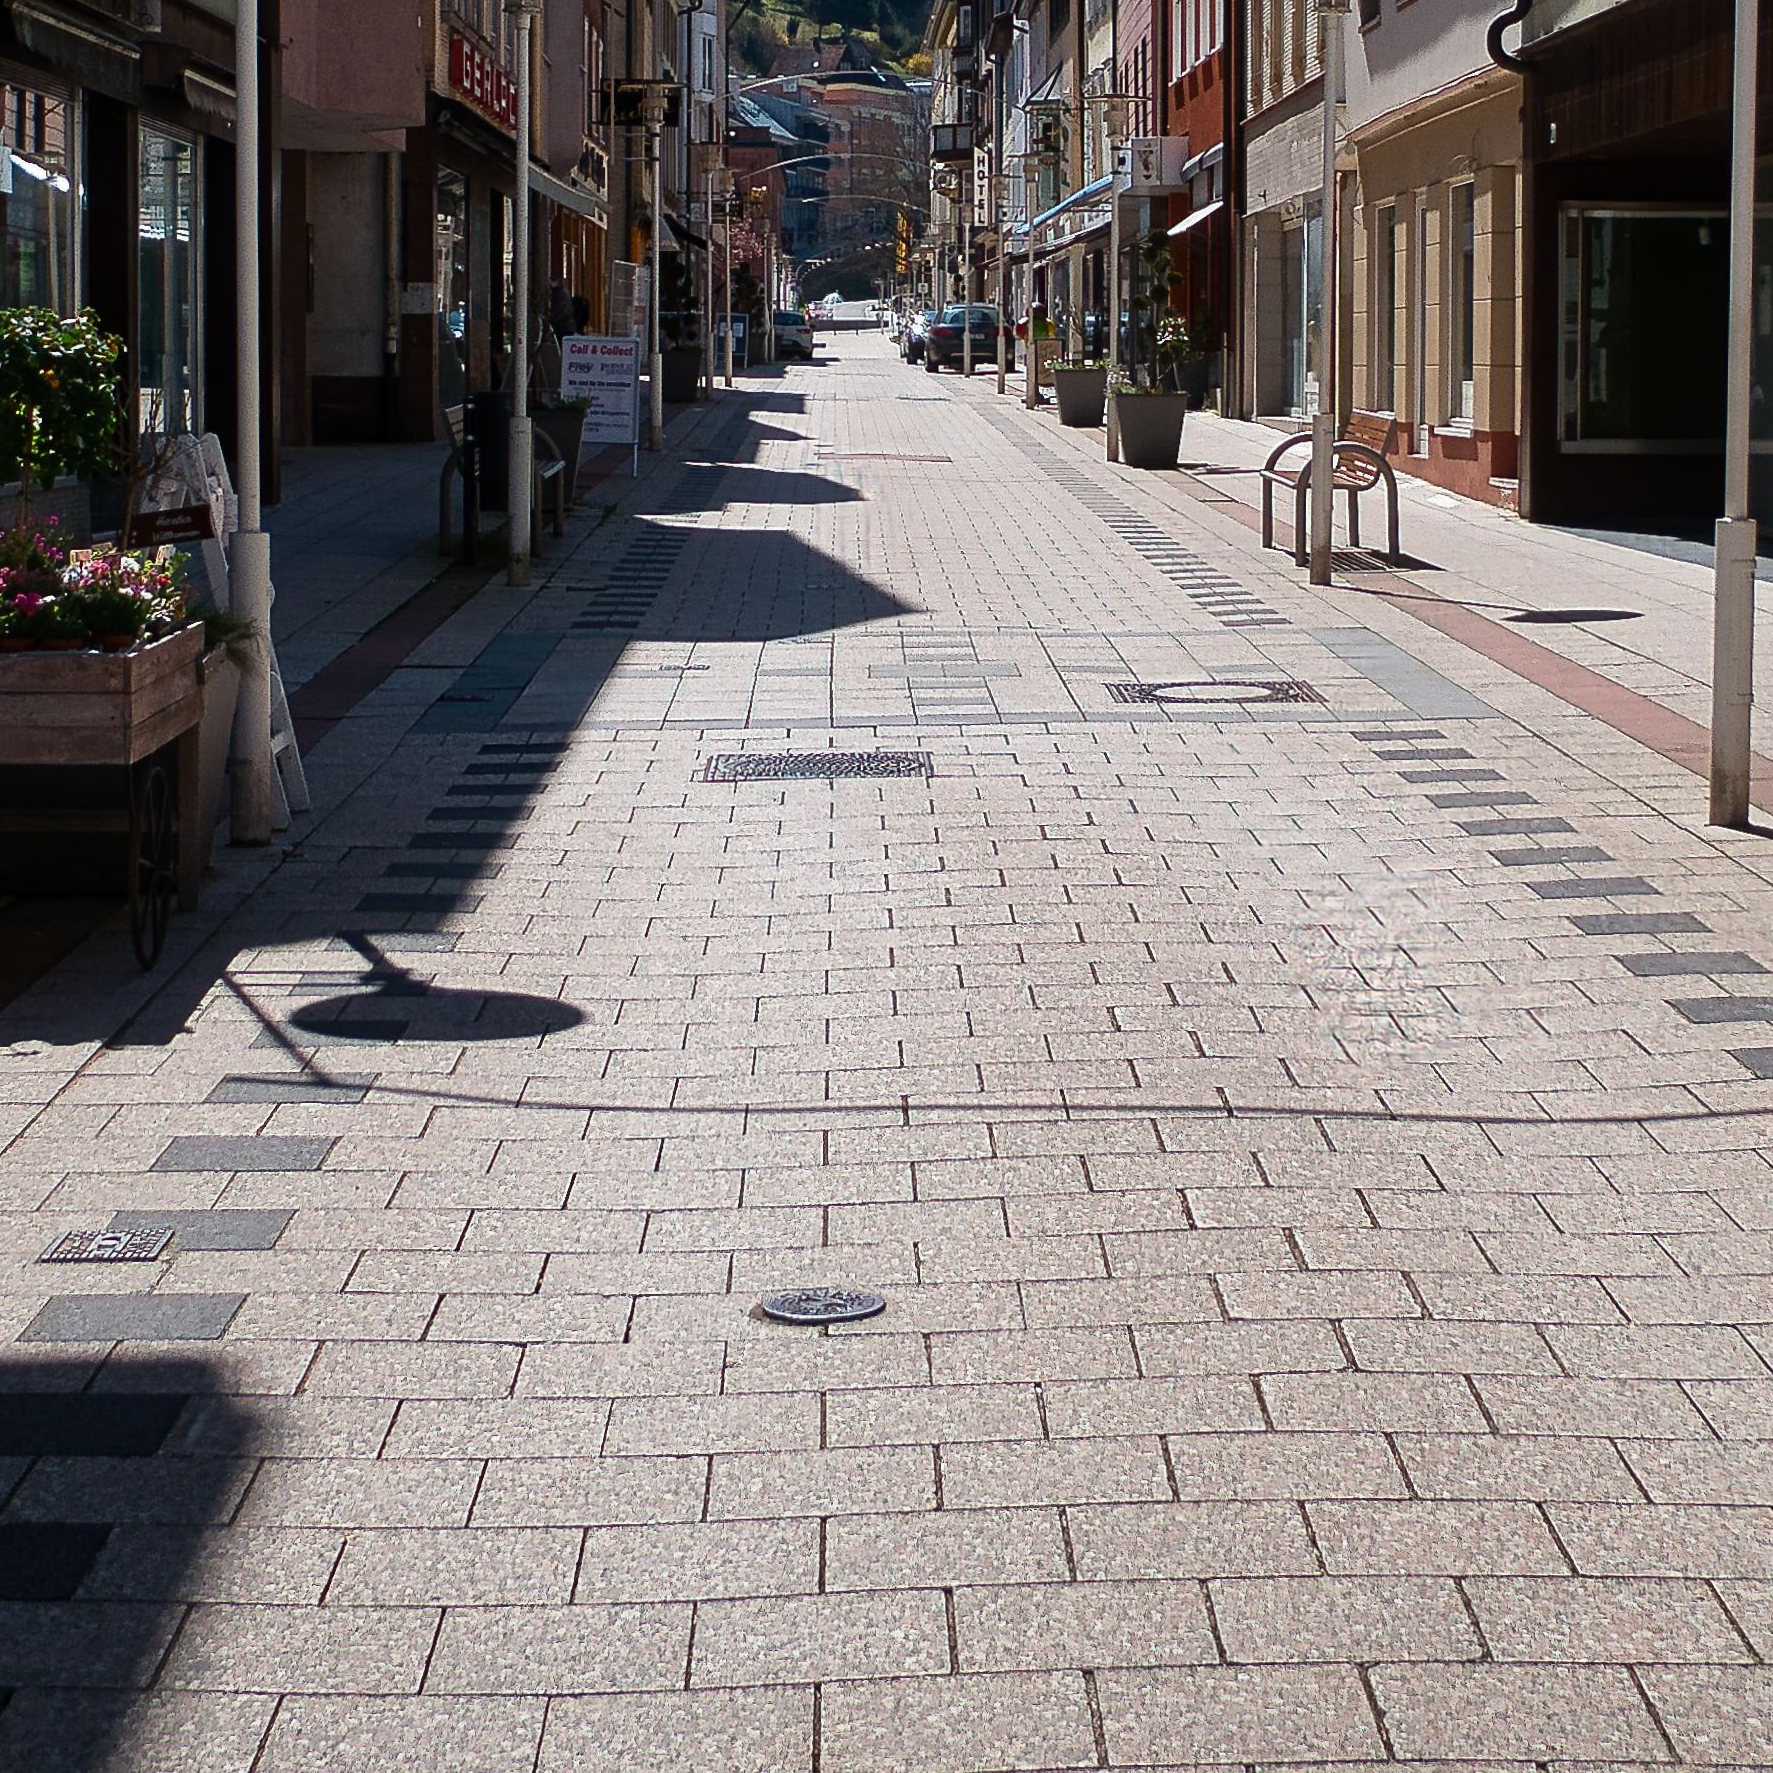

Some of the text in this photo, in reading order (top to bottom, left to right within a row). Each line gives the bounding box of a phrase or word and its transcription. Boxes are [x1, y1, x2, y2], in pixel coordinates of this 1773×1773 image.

[977, 155, 985, 224] HOTEL
[570, 344, 633, 356] Call & Collect
